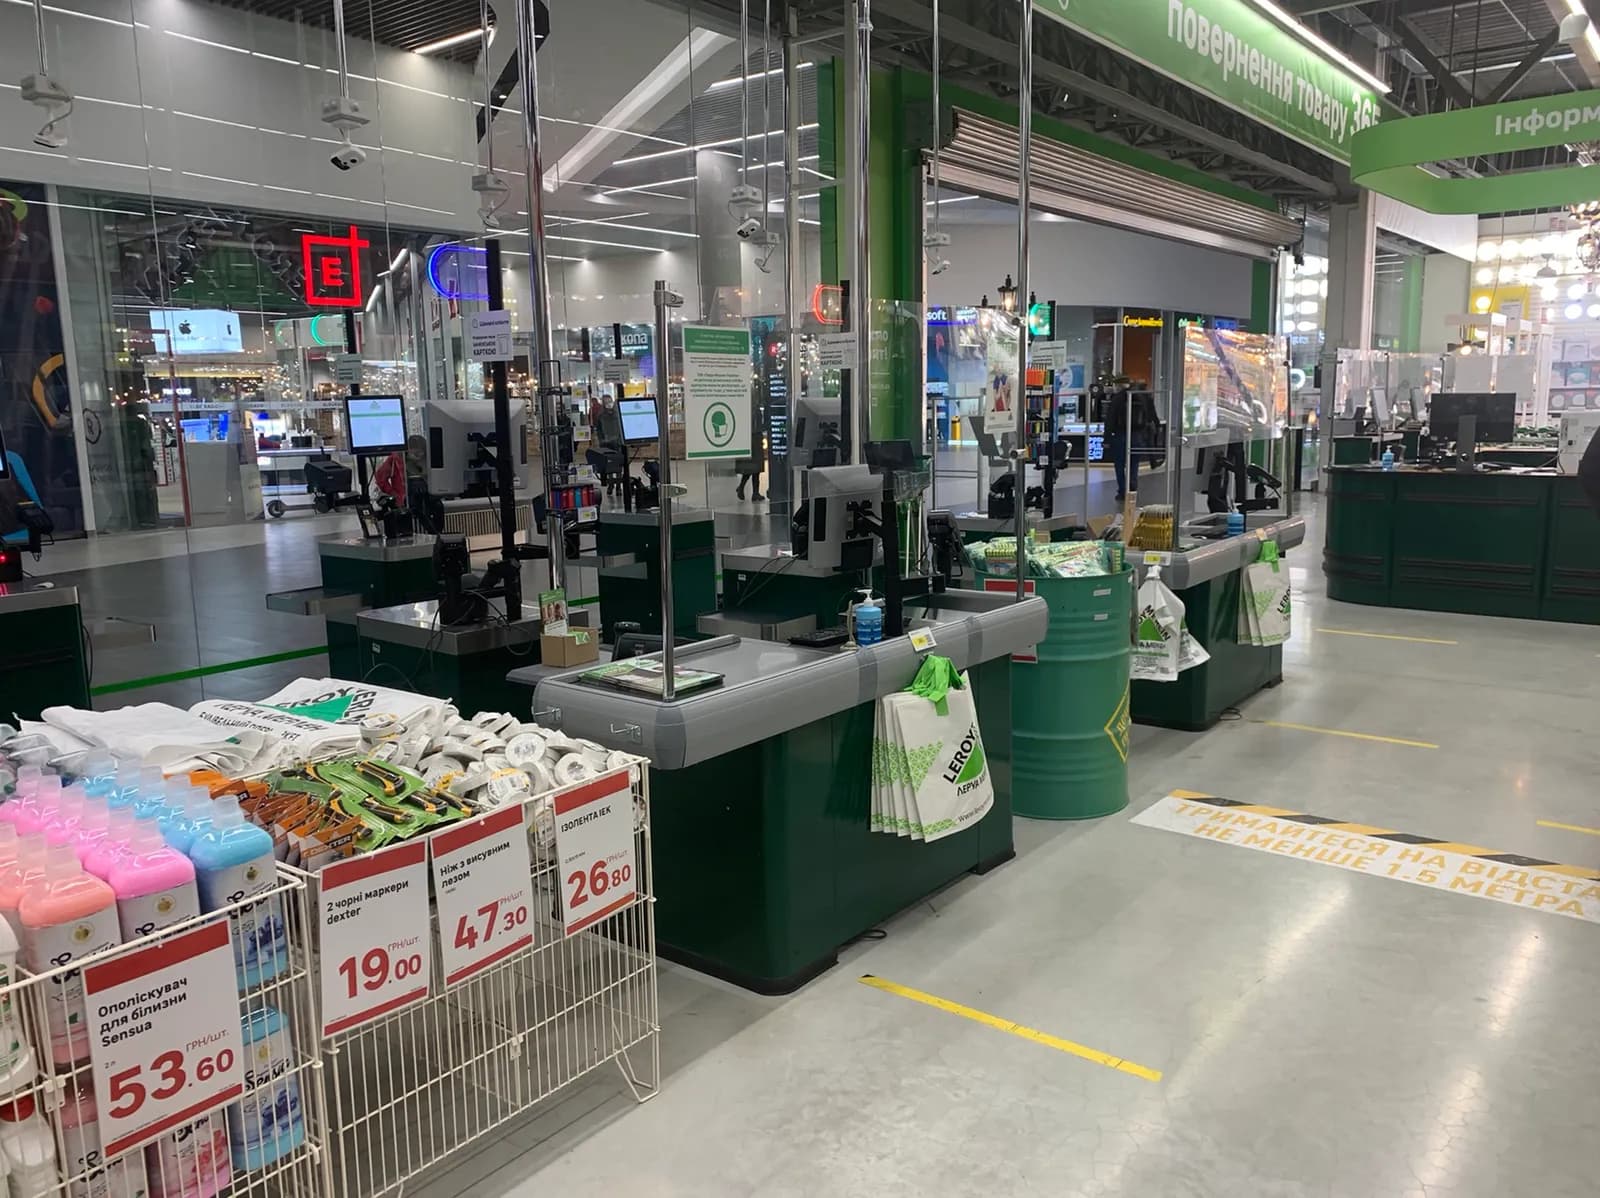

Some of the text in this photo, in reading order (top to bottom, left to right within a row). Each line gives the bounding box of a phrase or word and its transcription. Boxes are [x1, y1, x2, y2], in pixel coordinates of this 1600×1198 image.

[1168, 0, 1293, 104] повернення
[1297, 77, 1349, 144] товару
[608, 333, 648, 346] akona
[942, 727, 977, 785] LEROY
[561, 810, 599, 833] ІЗОЛЕНТА
[439, 862, 458, 877] Ніж
[466, 840, 511, 866] висувним
[441, 869, 470, 889] лезом
[1193, 823, 1585, 916] НЕ МЕНШЕ 1.5 МЕТРА
[1397, 848, 1447, 869] НА
[327, 879, 409, 912] 2 чорні маркери
[567, 859, 631, 909] 26.80
[327, 906, 362, 925] dexter
[454, 900, 527, 950] 47.30
[338, 947, 422, 999] 19.00
[98, 976, 188, 1018] Ополіскувач
[100, 991, 187, 1035] для білизни
[101, 1019, 153, 1048] Sensua
[108, 1048, 234, 1120] 53.60
